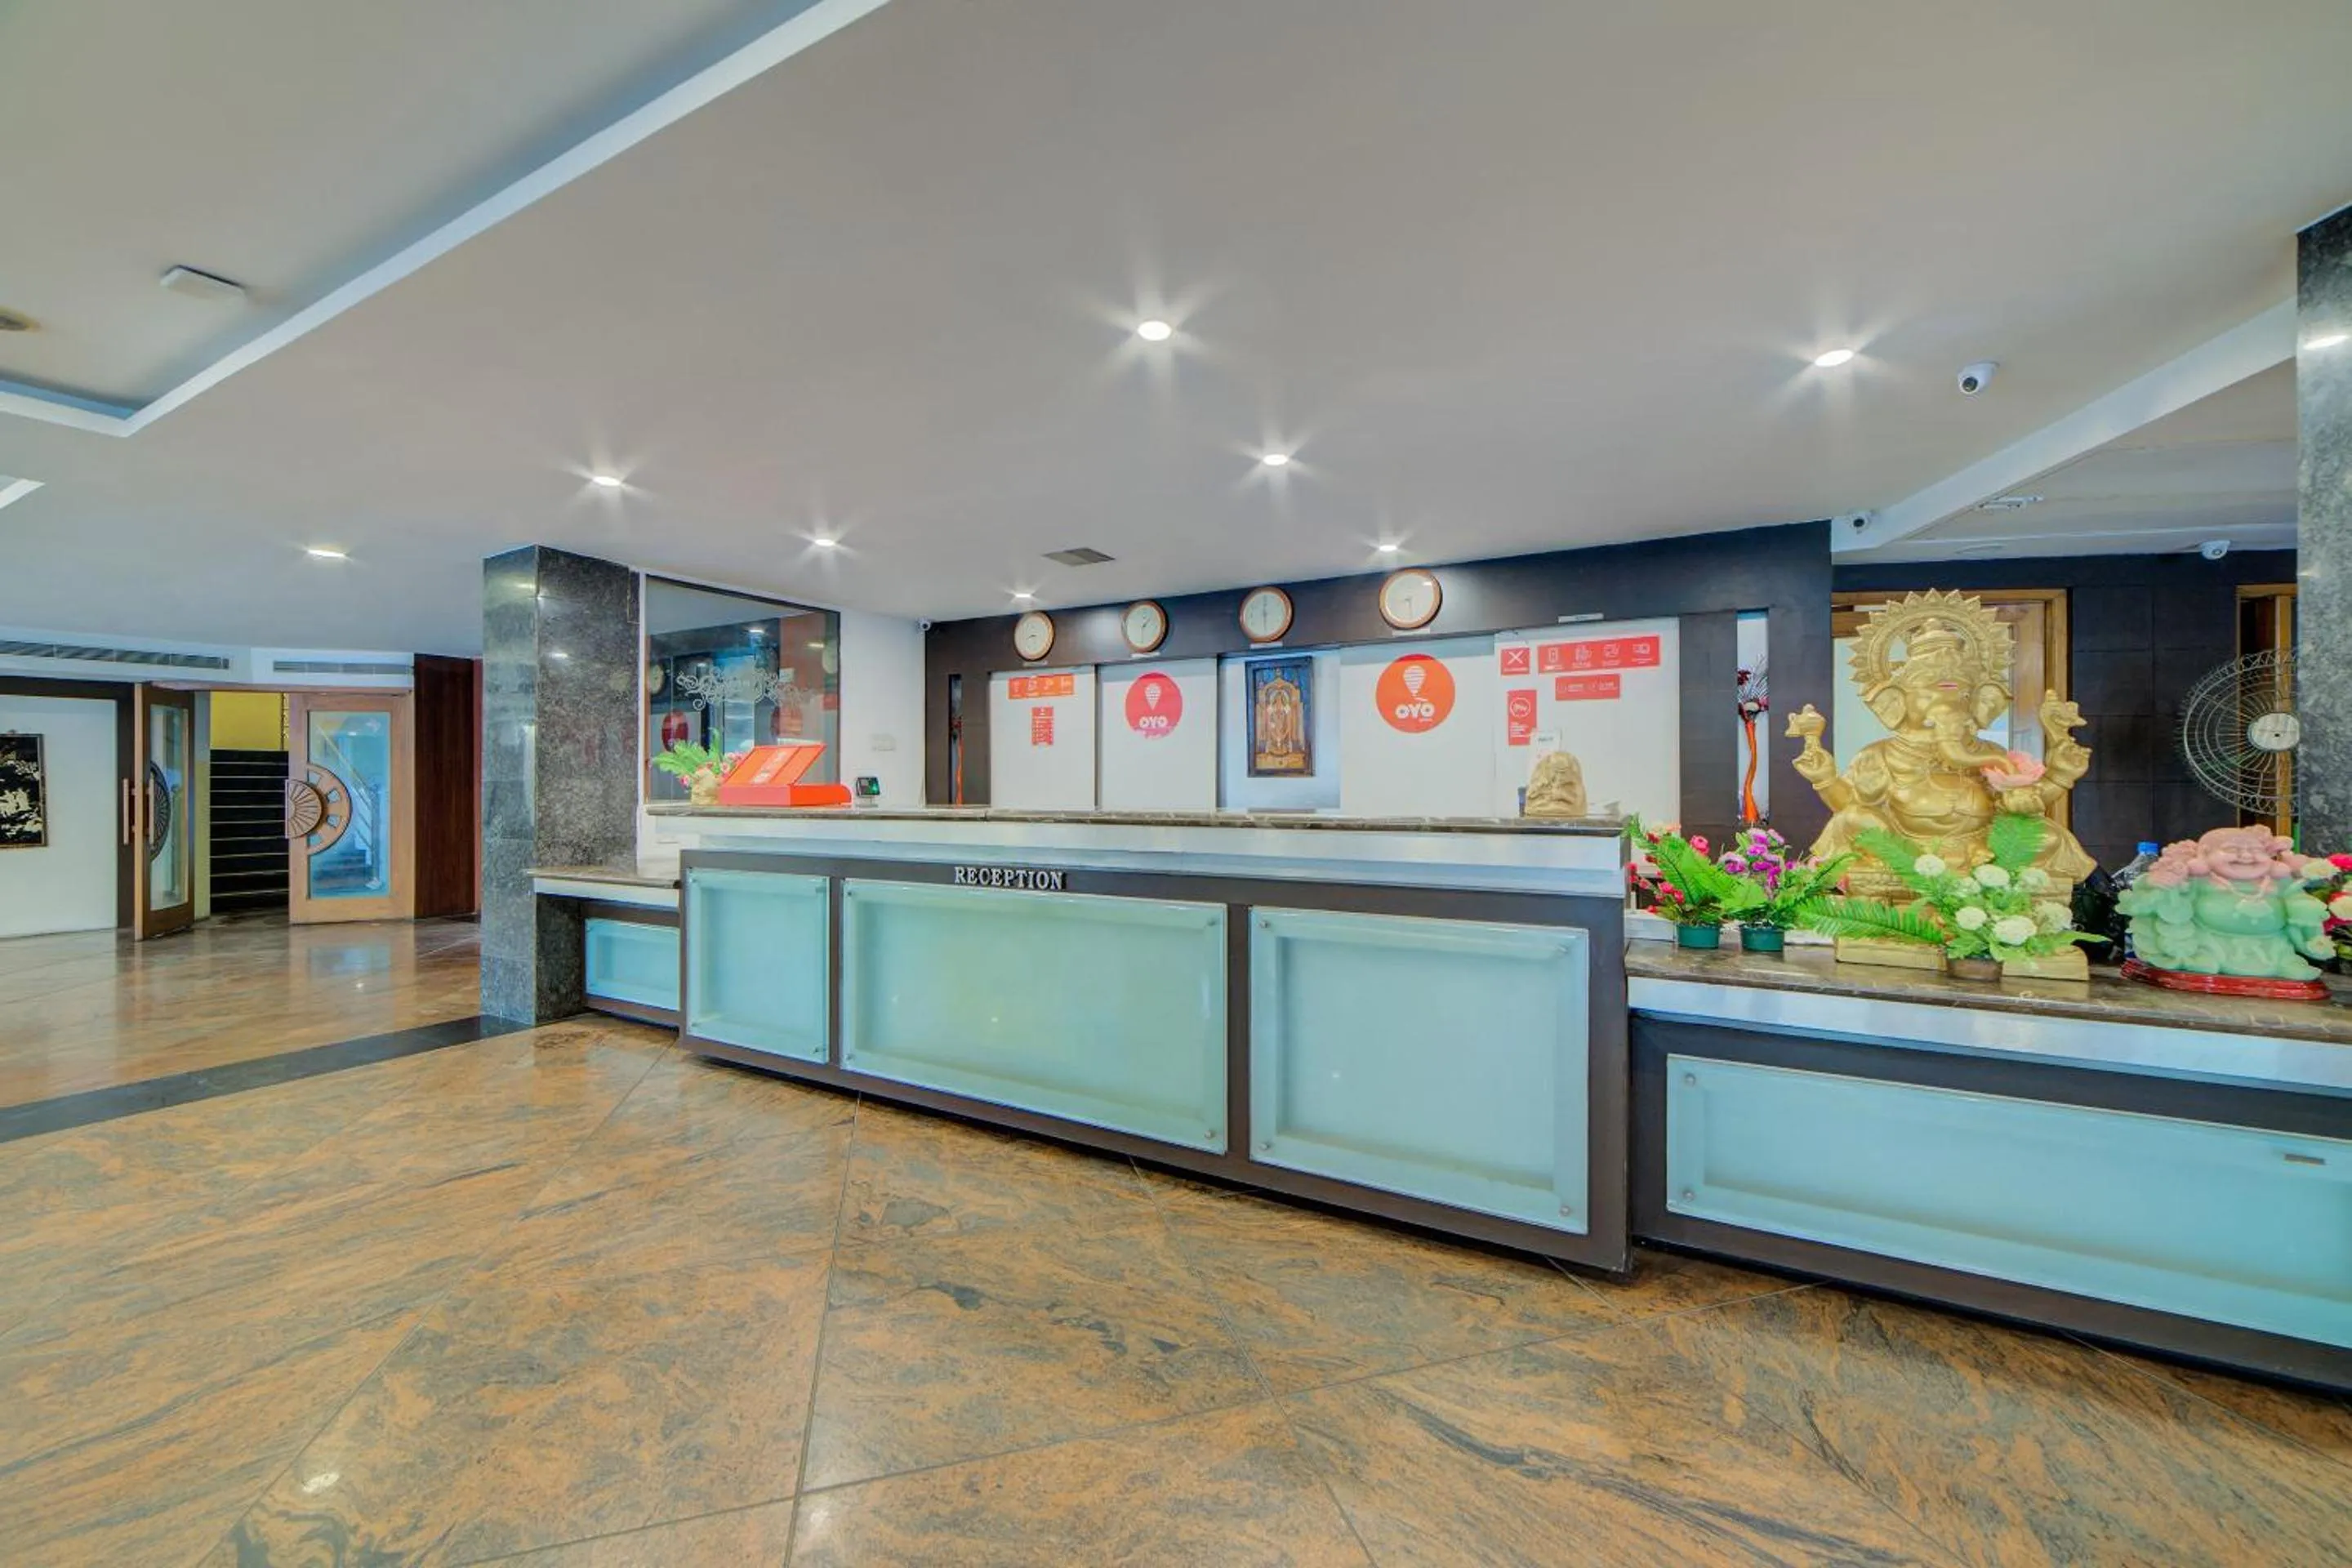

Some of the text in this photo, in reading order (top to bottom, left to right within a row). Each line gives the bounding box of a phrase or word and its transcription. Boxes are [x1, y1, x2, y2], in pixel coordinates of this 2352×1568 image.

[1395, 702, 1435, 719] OYO
[1139, 715, 1168, 728] OYO
[954, 866, 1062, 890] RECEPTION
